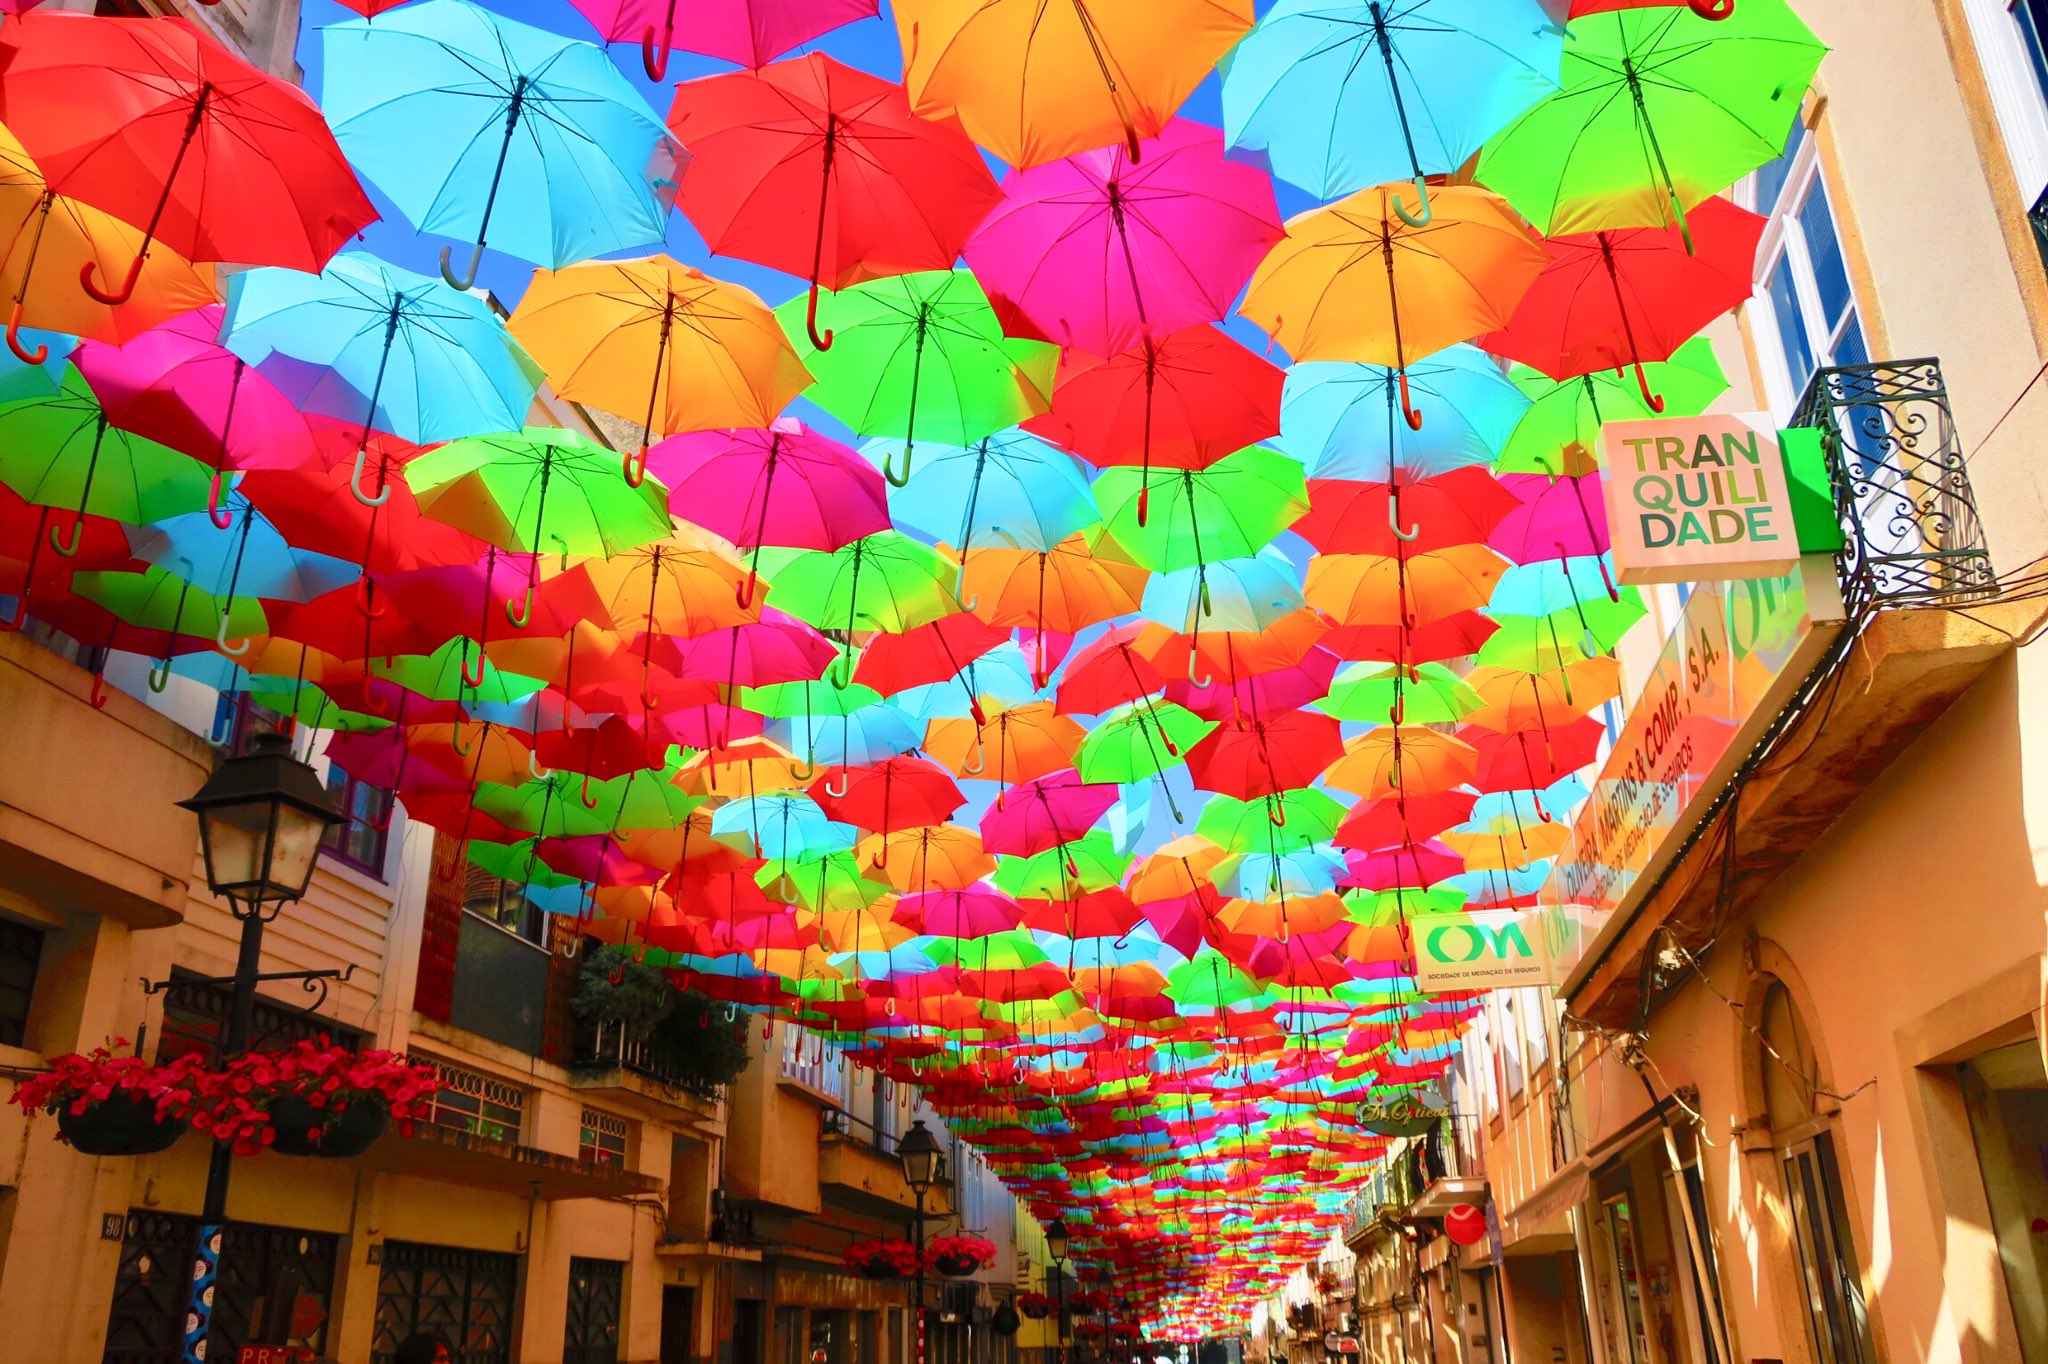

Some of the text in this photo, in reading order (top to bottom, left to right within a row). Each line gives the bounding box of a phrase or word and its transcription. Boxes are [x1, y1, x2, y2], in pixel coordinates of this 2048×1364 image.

[1621, 431, 1761, 472] TRAN
[1632, 468, 1769, 515] QUILI
[1639, 506, 1779, 549] DADE
[1599, 761, 1637, 851] MARTINS
[1635, 747, 1648, 788] &
[1688, 626, 1720, 694] S.A.
[1660, 735, 1693, 803] SEGUROS
[1428, 972, 1461, 980] SOCIEDADE
[1471, 967, 1504, 977] MEDIAÇÃO
[1514, 966, 1541, 974] SEGUROS
[106, 1216, 121, 1237] 98
